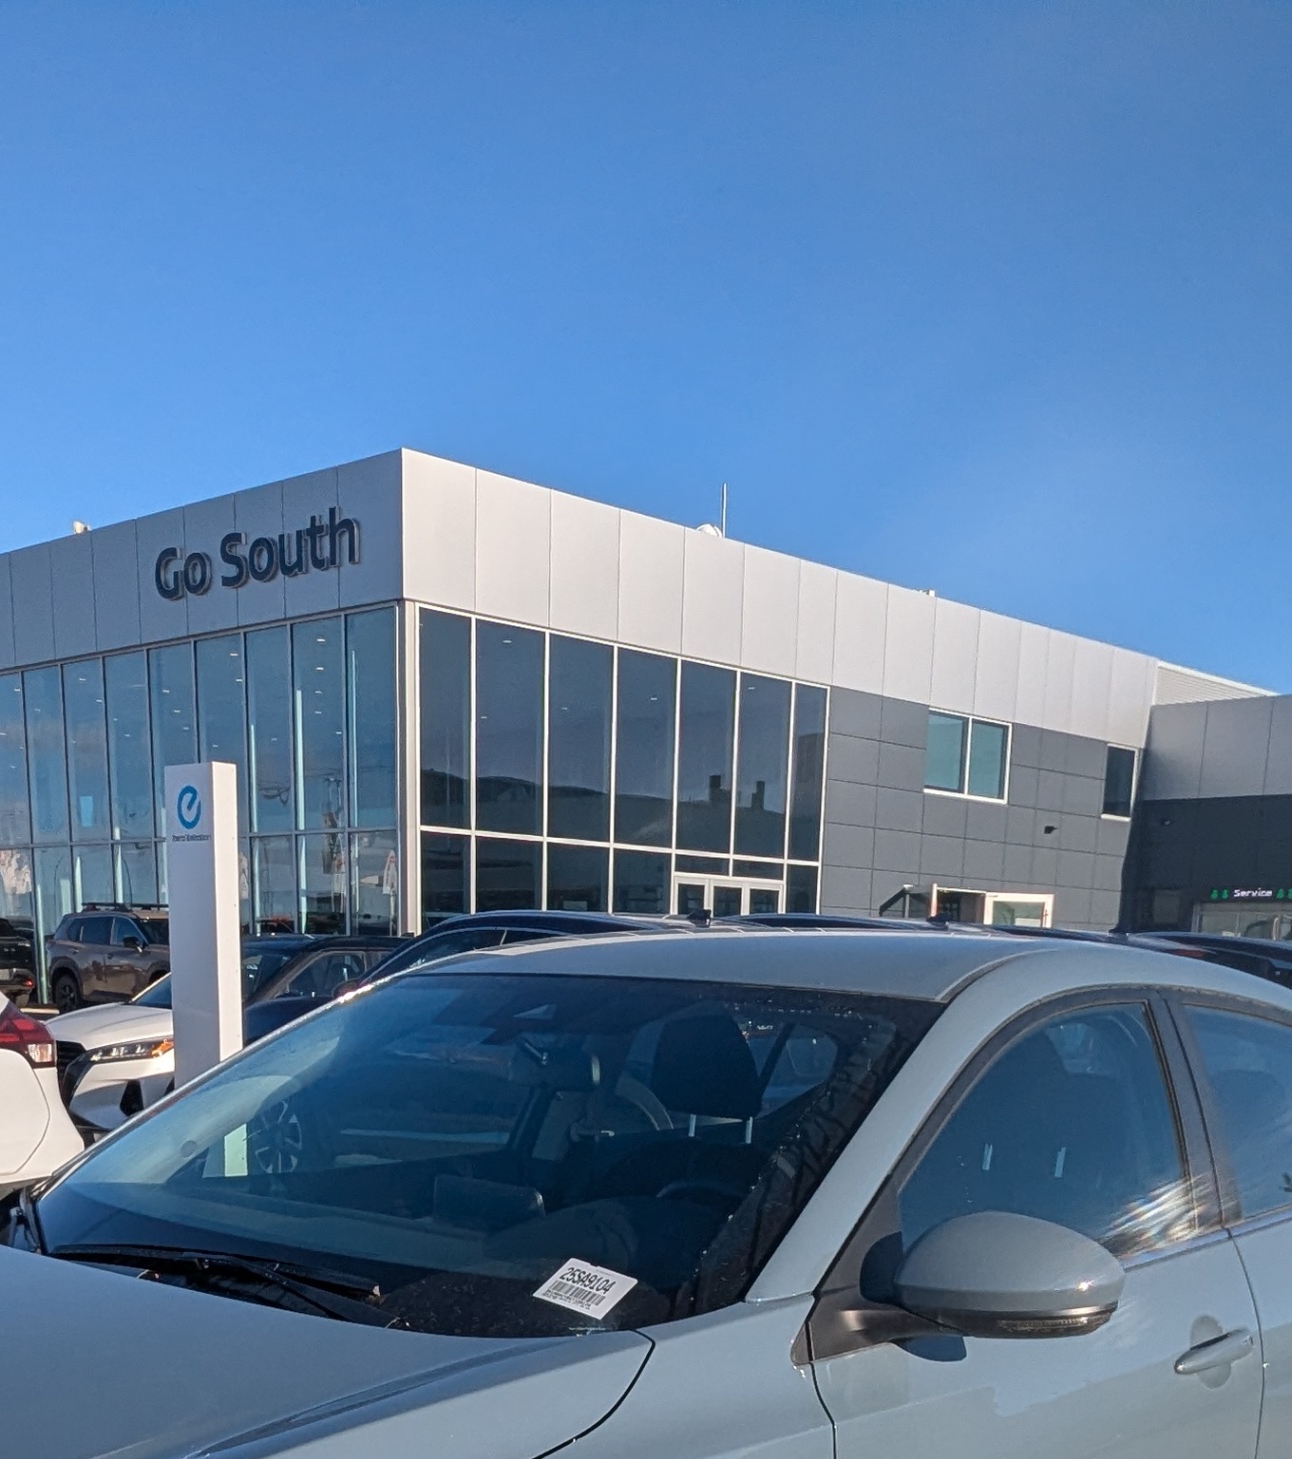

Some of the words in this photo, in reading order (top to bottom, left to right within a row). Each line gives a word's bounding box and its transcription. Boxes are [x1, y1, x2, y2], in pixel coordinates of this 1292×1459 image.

[154, 546, 212, 601] Go
[219, 505, 361, 589] South
[1233, 887, 1273, 898] Service
[559, 1266, 616, 1295] 25SA9104
